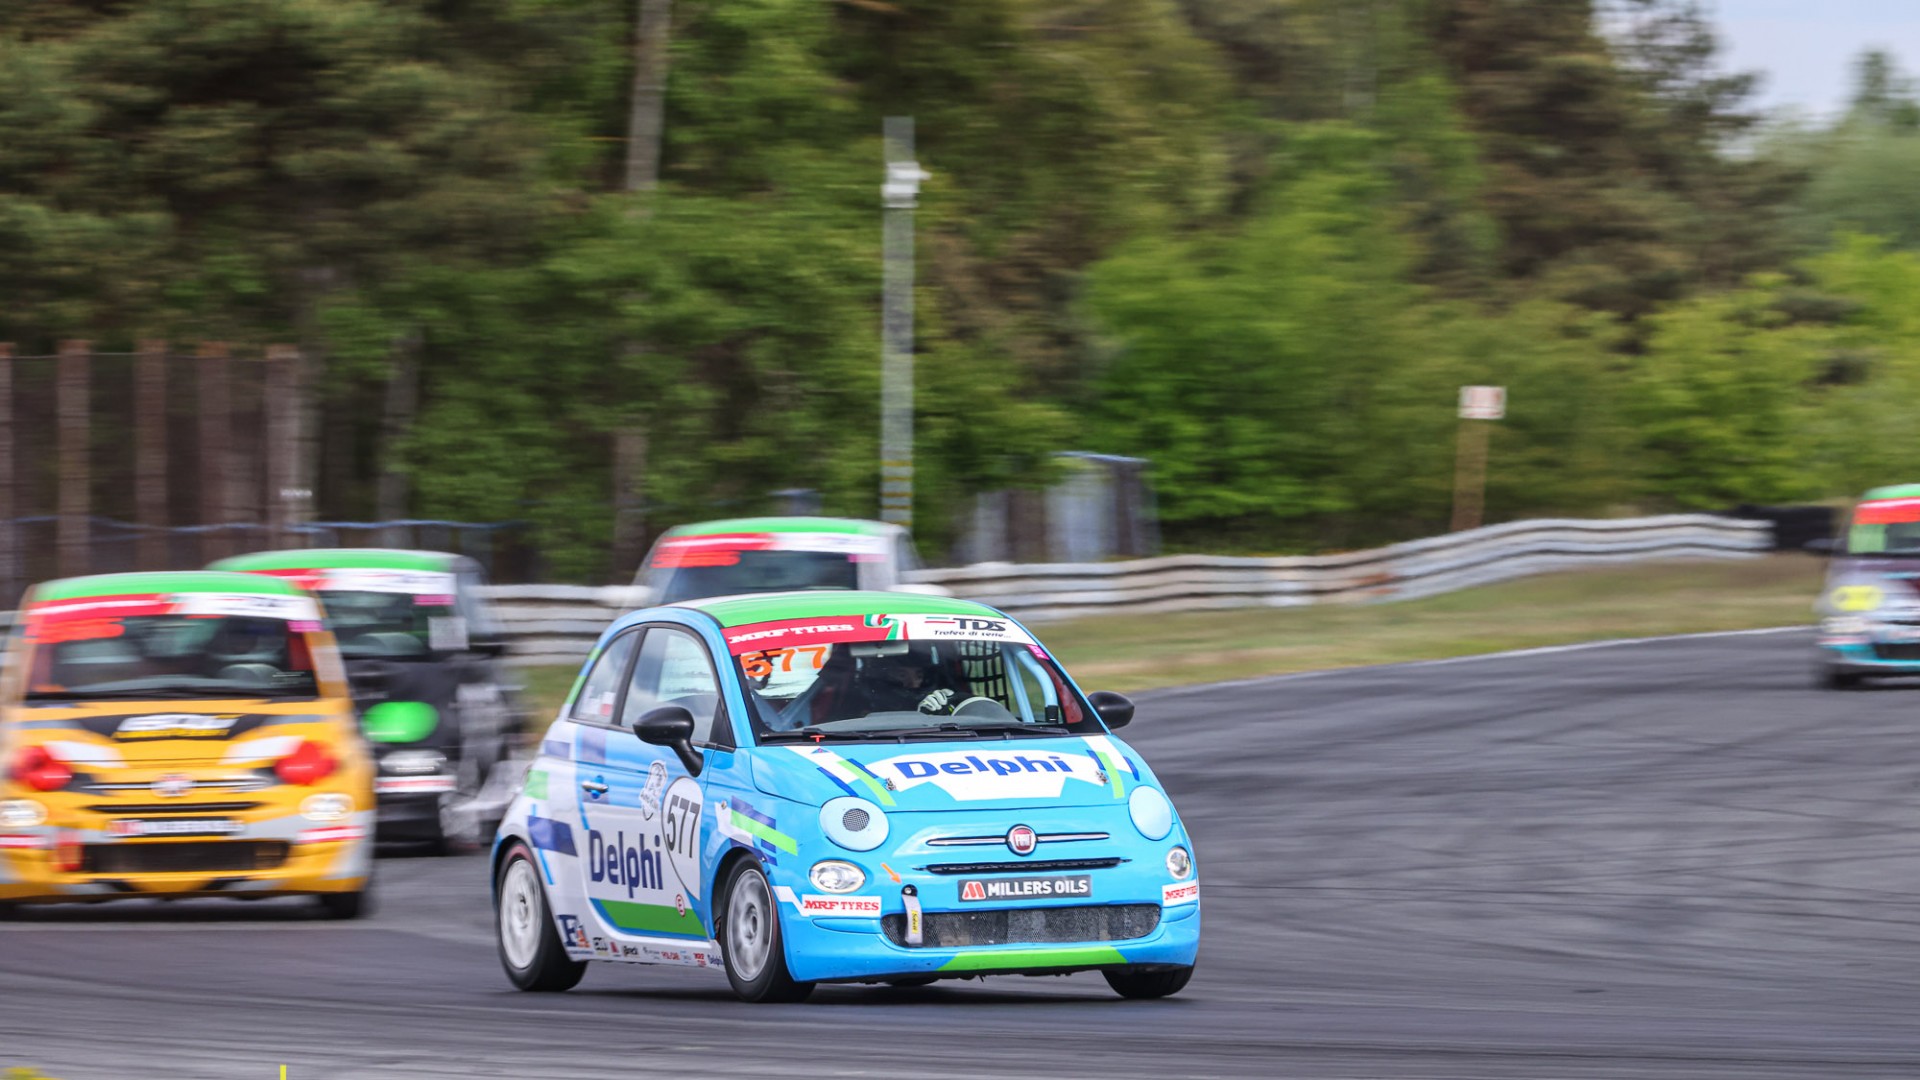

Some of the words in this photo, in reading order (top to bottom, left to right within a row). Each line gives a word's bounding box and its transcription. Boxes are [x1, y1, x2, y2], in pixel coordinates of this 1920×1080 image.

[728, 628, 789, 644] MRF
[790, 624, 855, 635] TYRES
[953, 617, 1006, 632] TDS
[740, 646, 827, 677] 577
[893, 756, 1073, 779] Delphi
[666, 794, 701, 859] 577
[589, 829, 664, 899] Delphi
[987, 881, 1052, 896] MILLERS
[1054, 880, 1089, 894] OILS
[804, 900, 839, 910] MRF
[841, 901, 880, 911] TYRES
